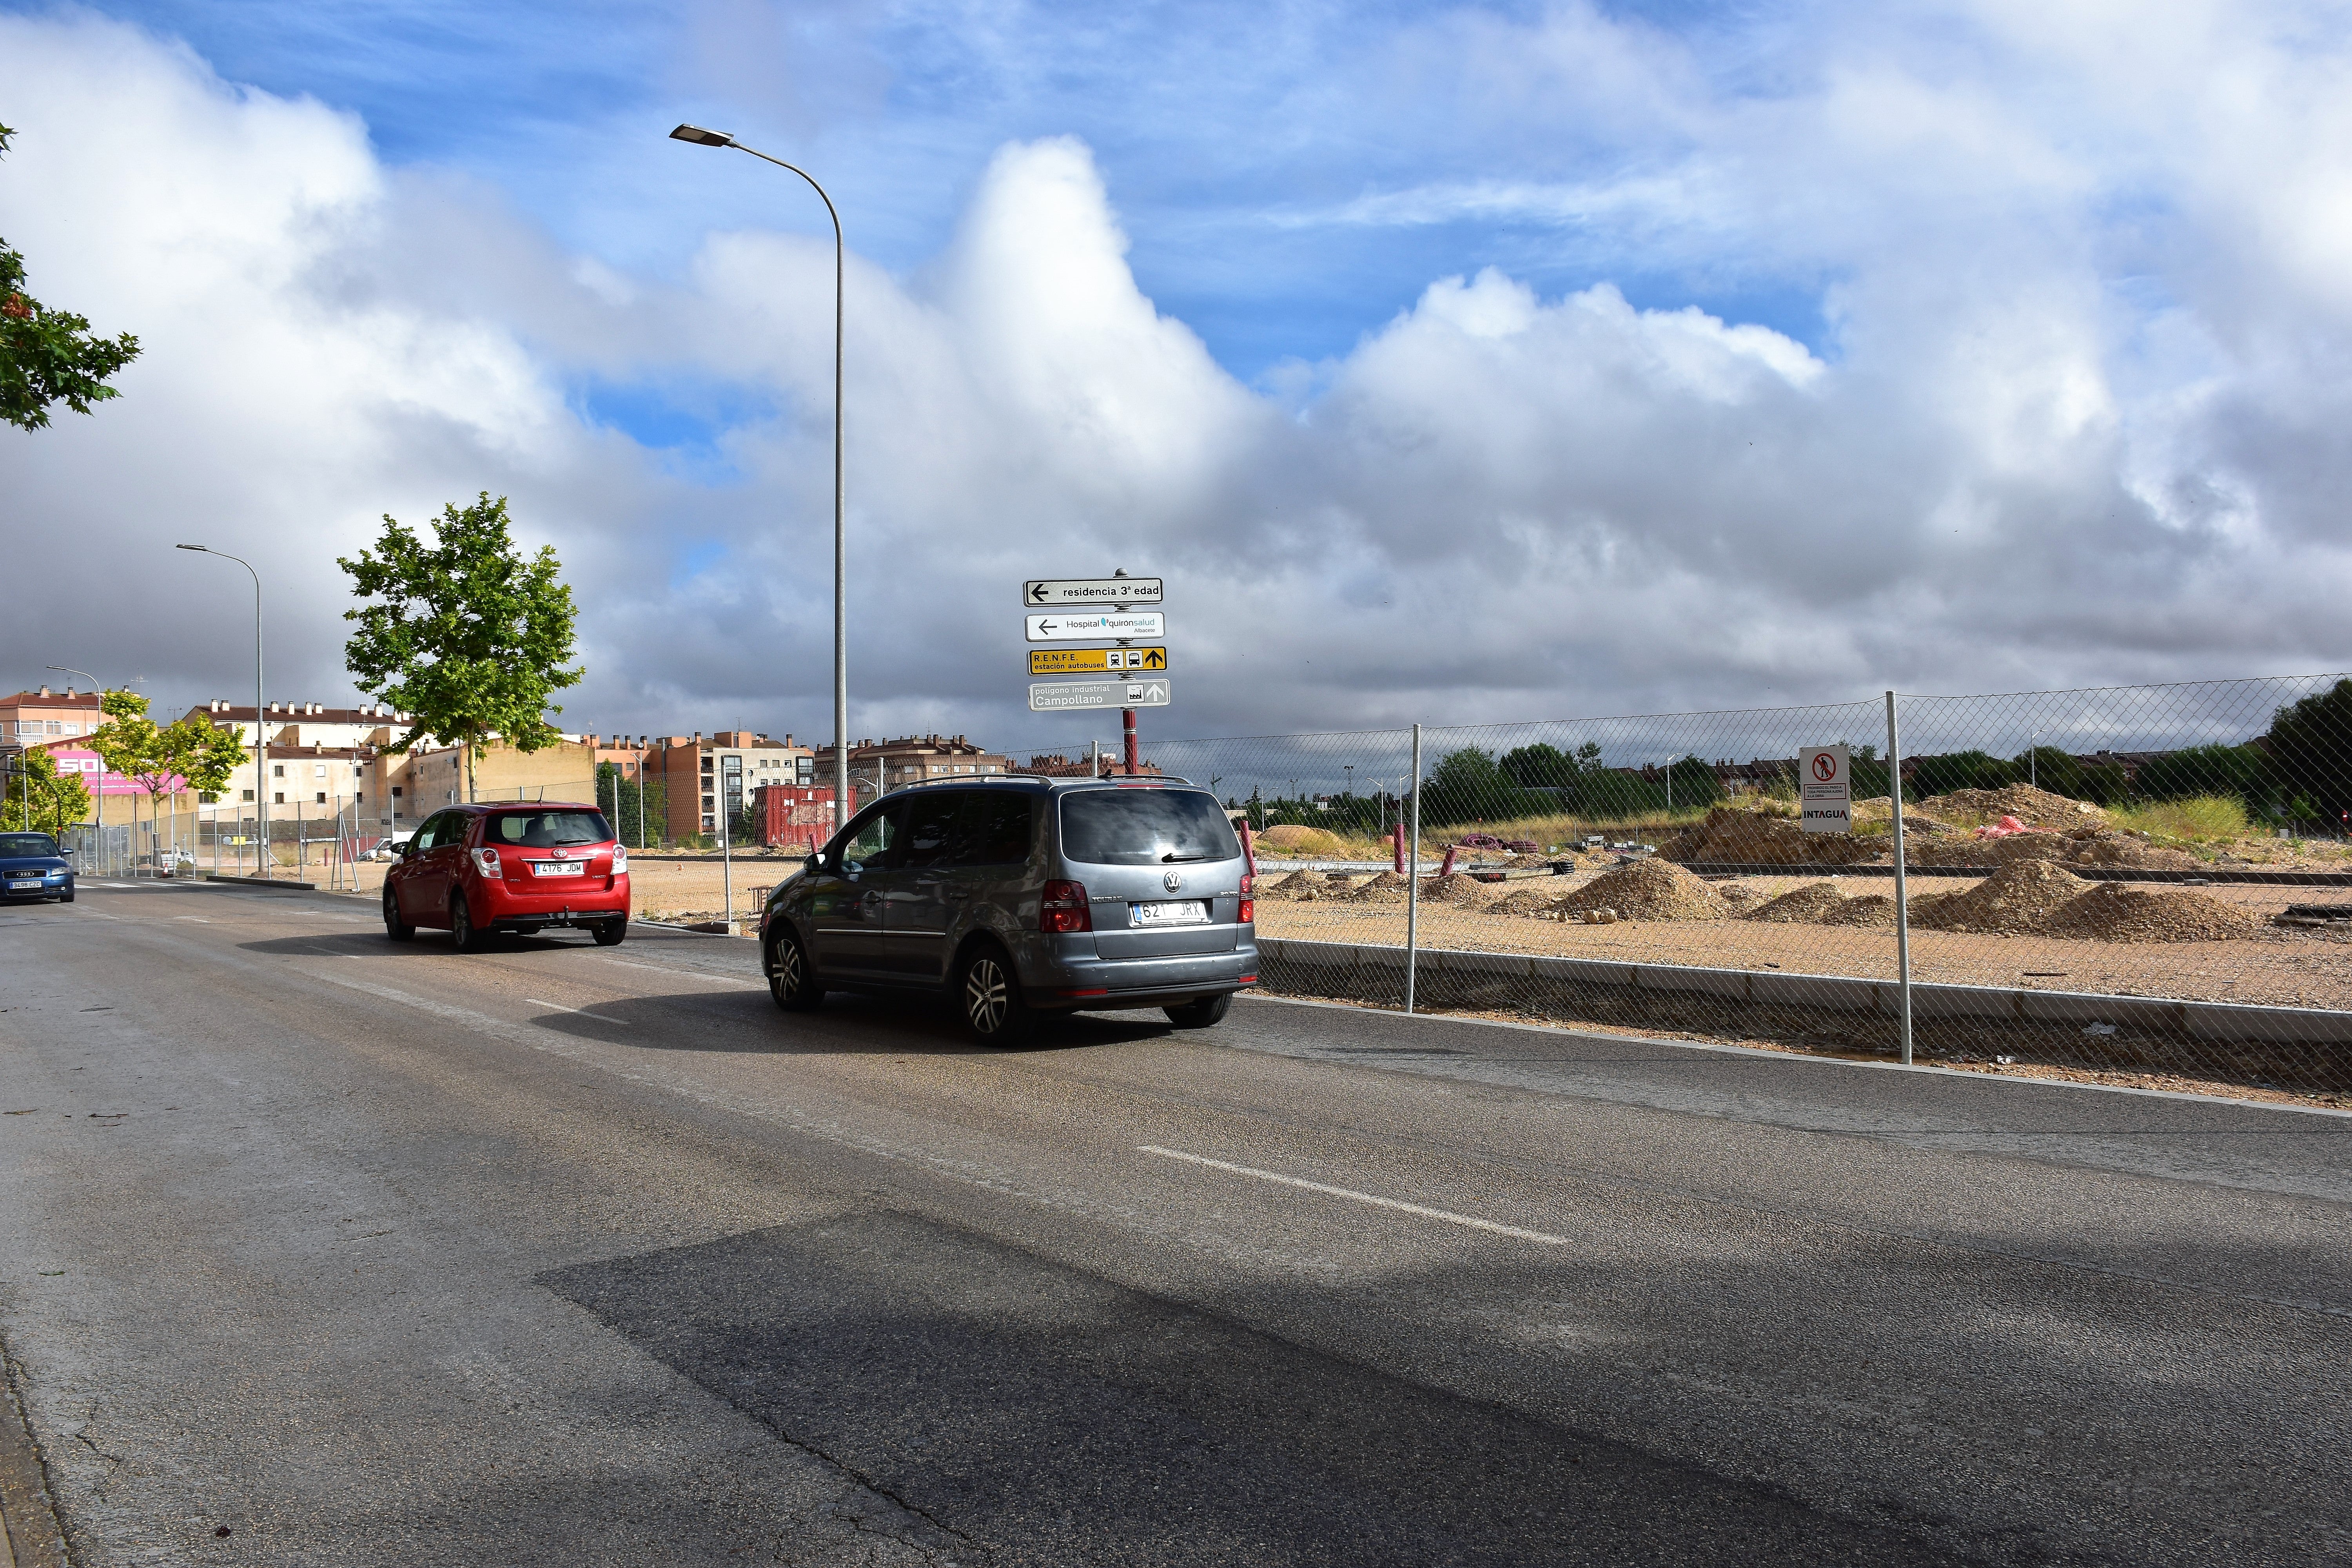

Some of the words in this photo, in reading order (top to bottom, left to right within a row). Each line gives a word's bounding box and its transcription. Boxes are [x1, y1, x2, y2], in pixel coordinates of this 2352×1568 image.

[1063, 587, 1116, 596] residencia
[1121, 586, 1131, 595] 3ª
[1134, 586, 1159, 595] edad
[1067, 620, 1099, 629] Hospital
[1109, 618, 1154, 629] quirónsalud
[1035, 687, 1069, 695] polígono
[1036, 695, 1103, 706] Campollano
[1804, 810, 1848, 821] INTAGUA
[543, 864, 562, 872] 4176
[567, 864, 581, 872] JDM
[1143, 904, 1170, 917] 621
[1180, 903, 1200, 916] JRX
